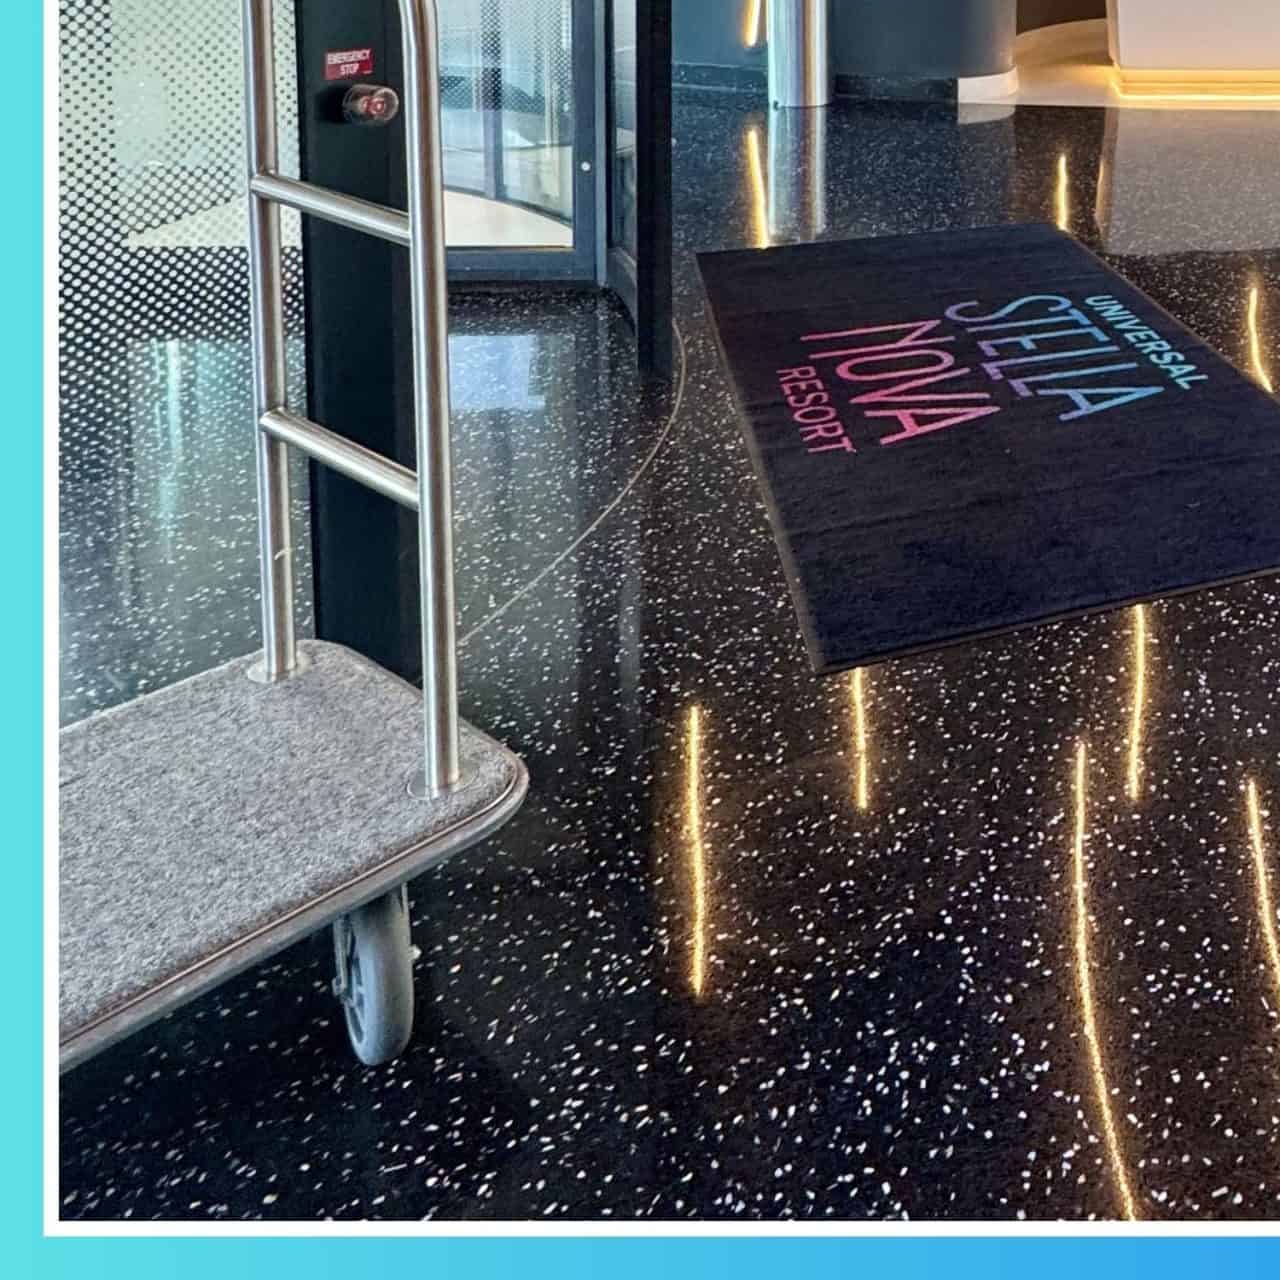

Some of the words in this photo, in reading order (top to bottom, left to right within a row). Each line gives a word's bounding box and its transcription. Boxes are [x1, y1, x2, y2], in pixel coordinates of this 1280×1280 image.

[326, 49, 371, 64] EMERGENCY
[340, 62, 360, 76] STOP
[800, 319, 1000, 446] NOVA
[944, 294, 1165, 421] STELLA
[1084, 294, 1209, 390] UNIVERSAL
[776, 365, 856, 454] RESORT
